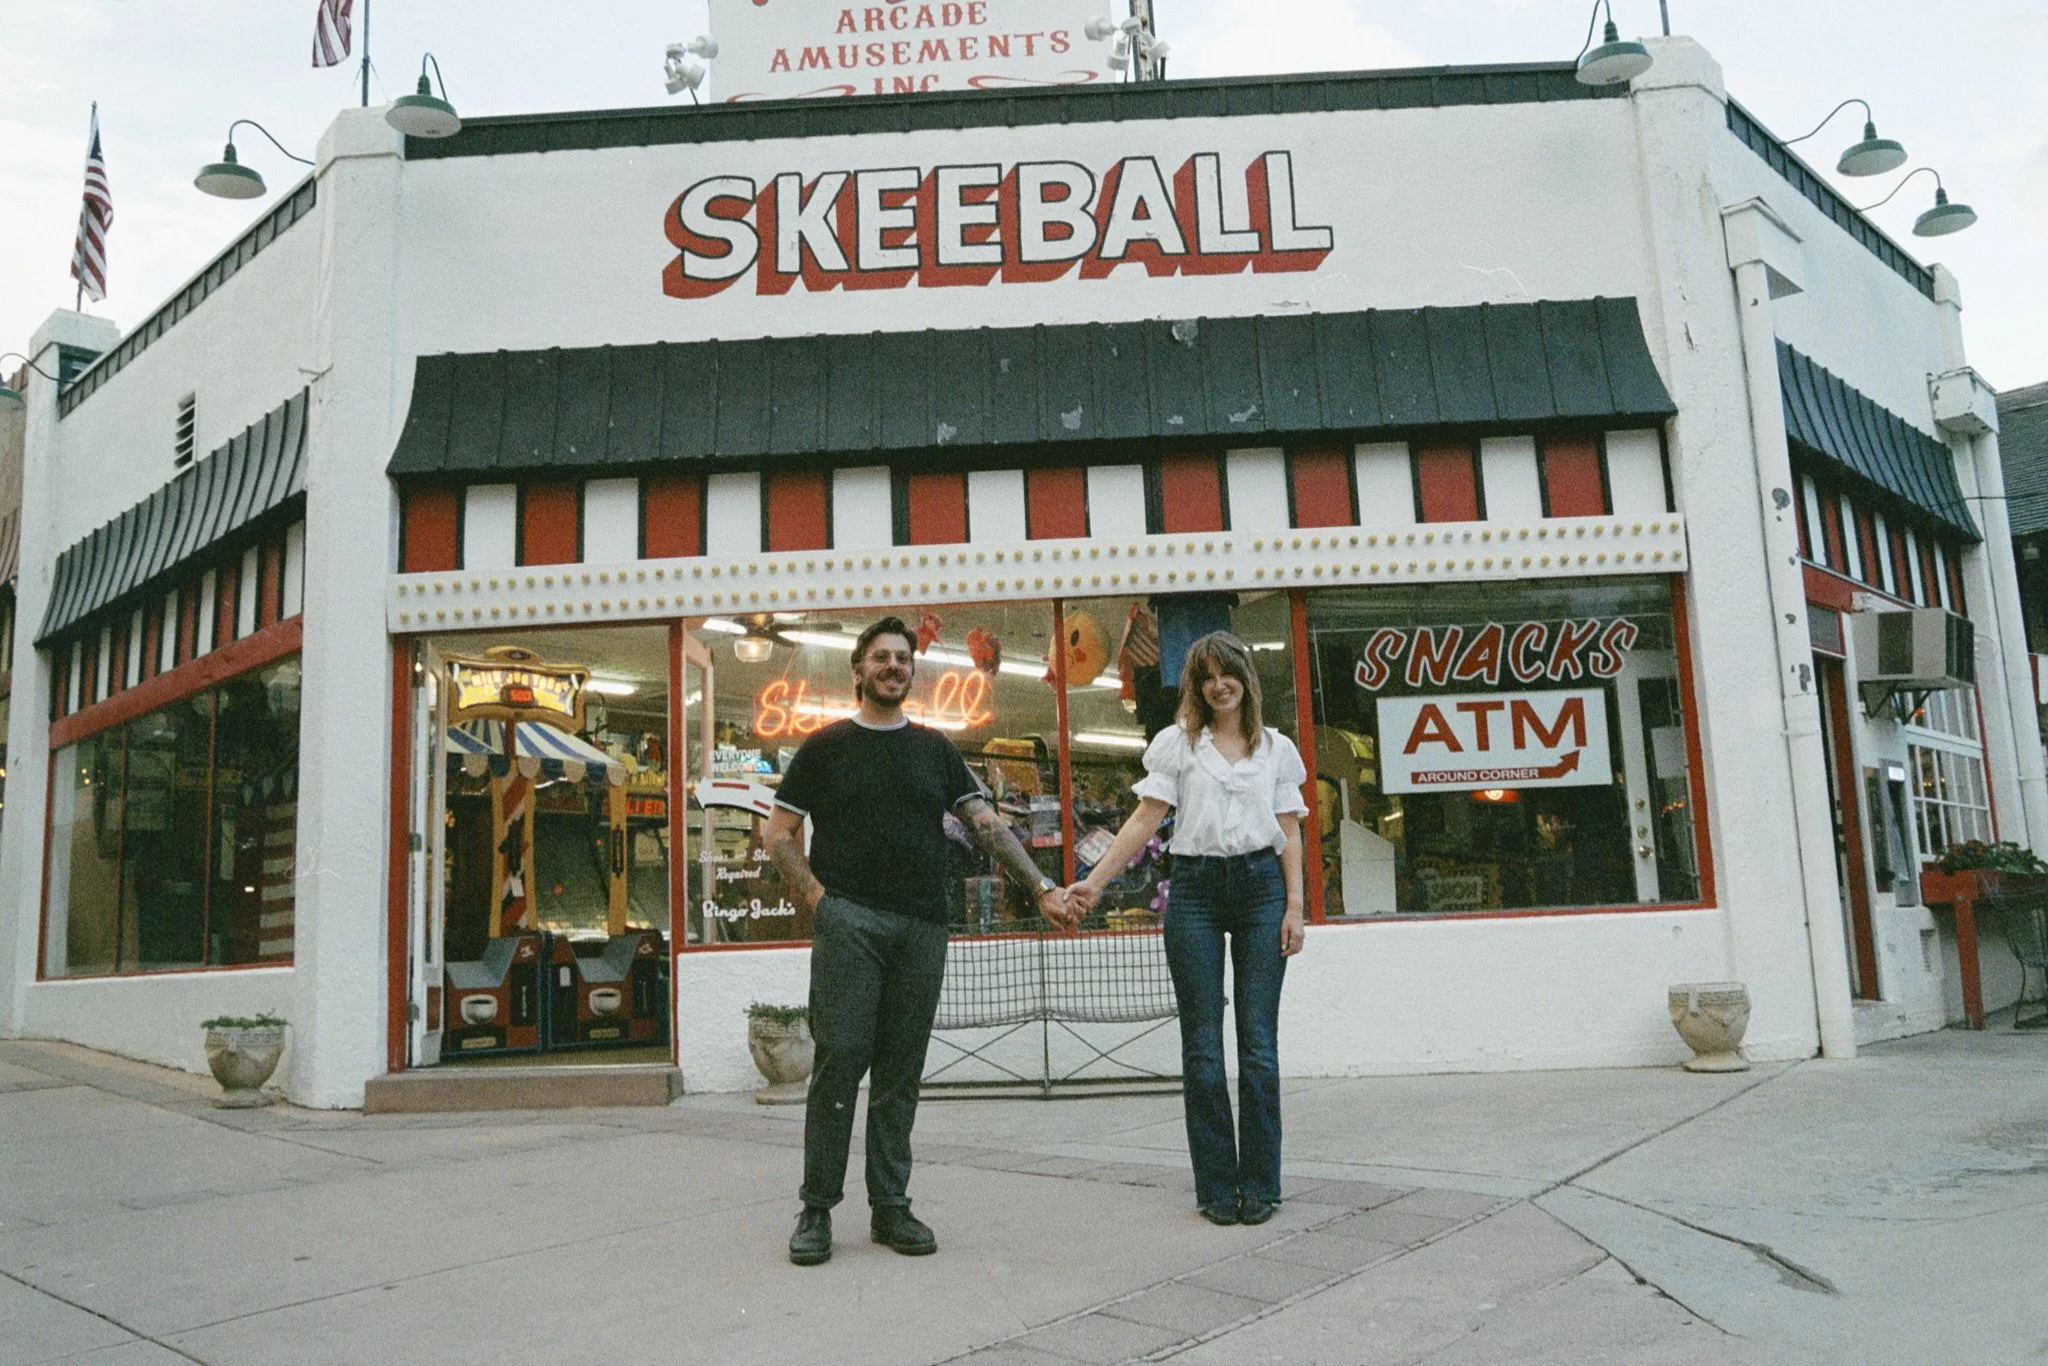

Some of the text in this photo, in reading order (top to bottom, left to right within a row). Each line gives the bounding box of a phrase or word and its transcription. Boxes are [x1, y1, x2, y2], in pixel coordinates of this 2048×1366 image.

[834, 1, 988, 34] ARCADE
[767, 30, 1071, 73] AMUSEMENTS
[663, 150, 1334, 300] SKEEBALL
[1355, 618, 1639, 691] SNACKS
[1402, 697, 1588, 755] ATM
[1417, 768, 1539, 783] AROUND CORNER
[716, 866, 762, 884] Required
[702, 898, 796, 923] Bingo Jack's
